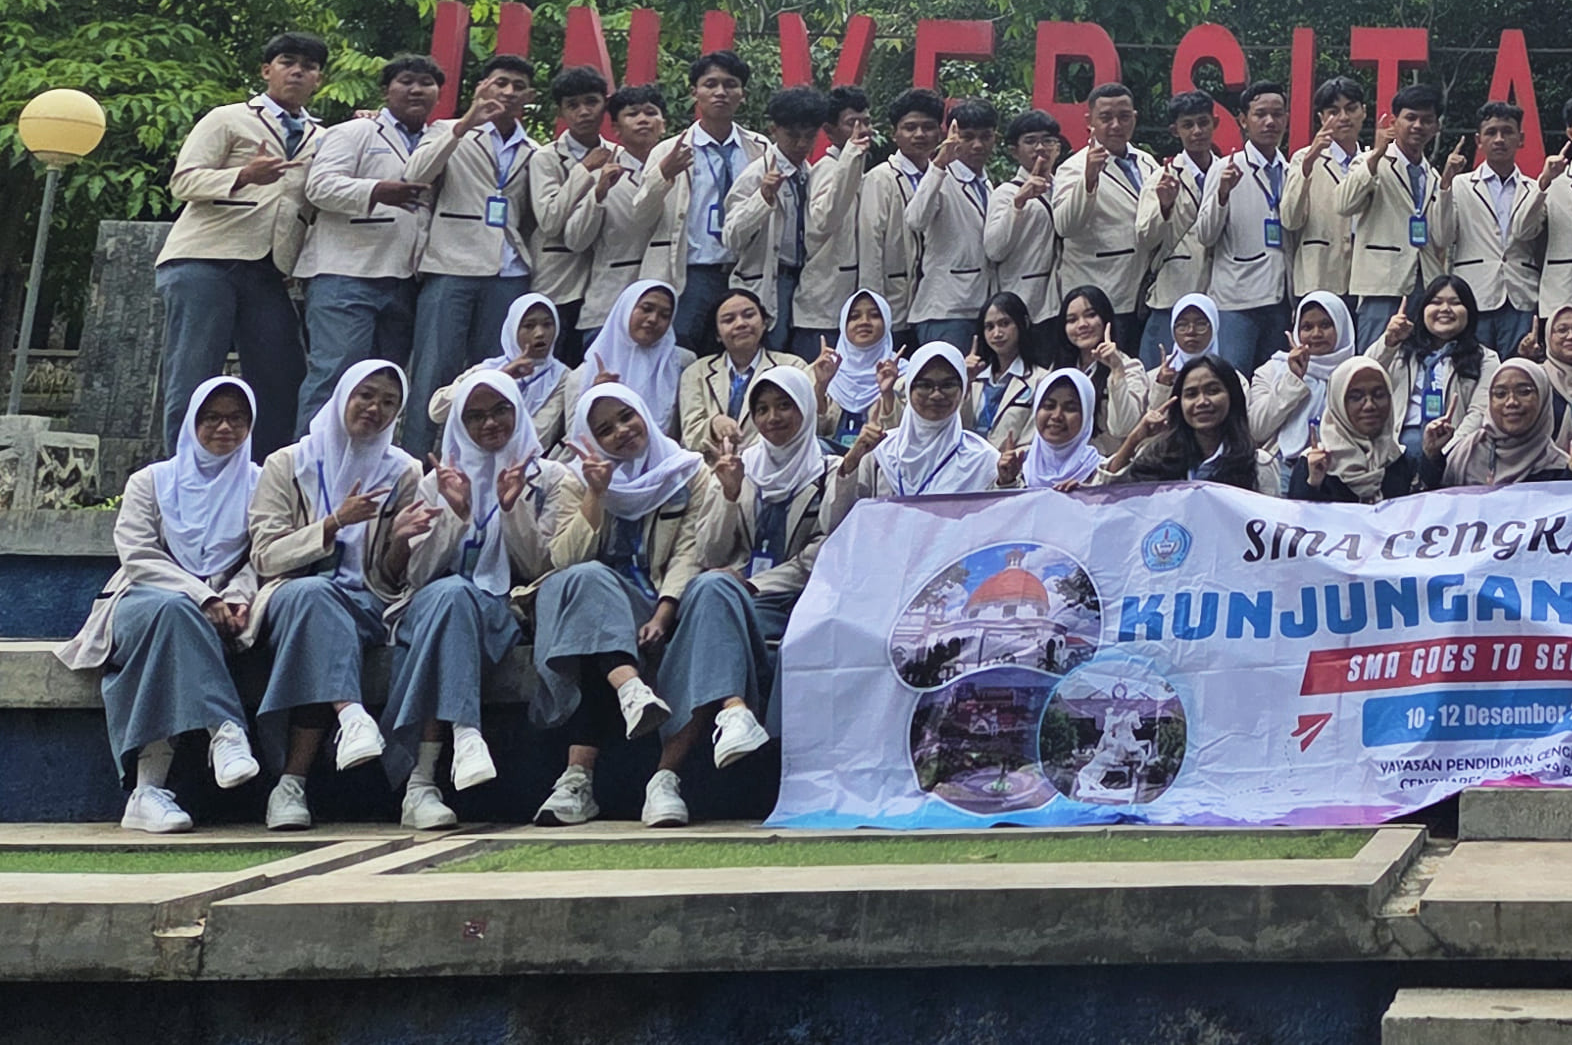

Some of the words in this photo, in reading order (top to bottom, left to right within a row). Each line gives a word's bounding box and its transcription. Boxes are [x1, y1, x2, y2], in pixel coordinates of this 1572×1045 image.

[1242, 518, 1363, 563] SMA
[1346, 651, 1400, 682] SMA
[1410, 643, 1477, 679] GOES
[1491, 643, 1523, 671] TO
[1405, 706, 1426, 729] 10
[1438, 704, 1460, 727] 12
[1464, 702, 1566, 726] Desember
[1446, 754, 1534, 772] PENDIDIKAN
